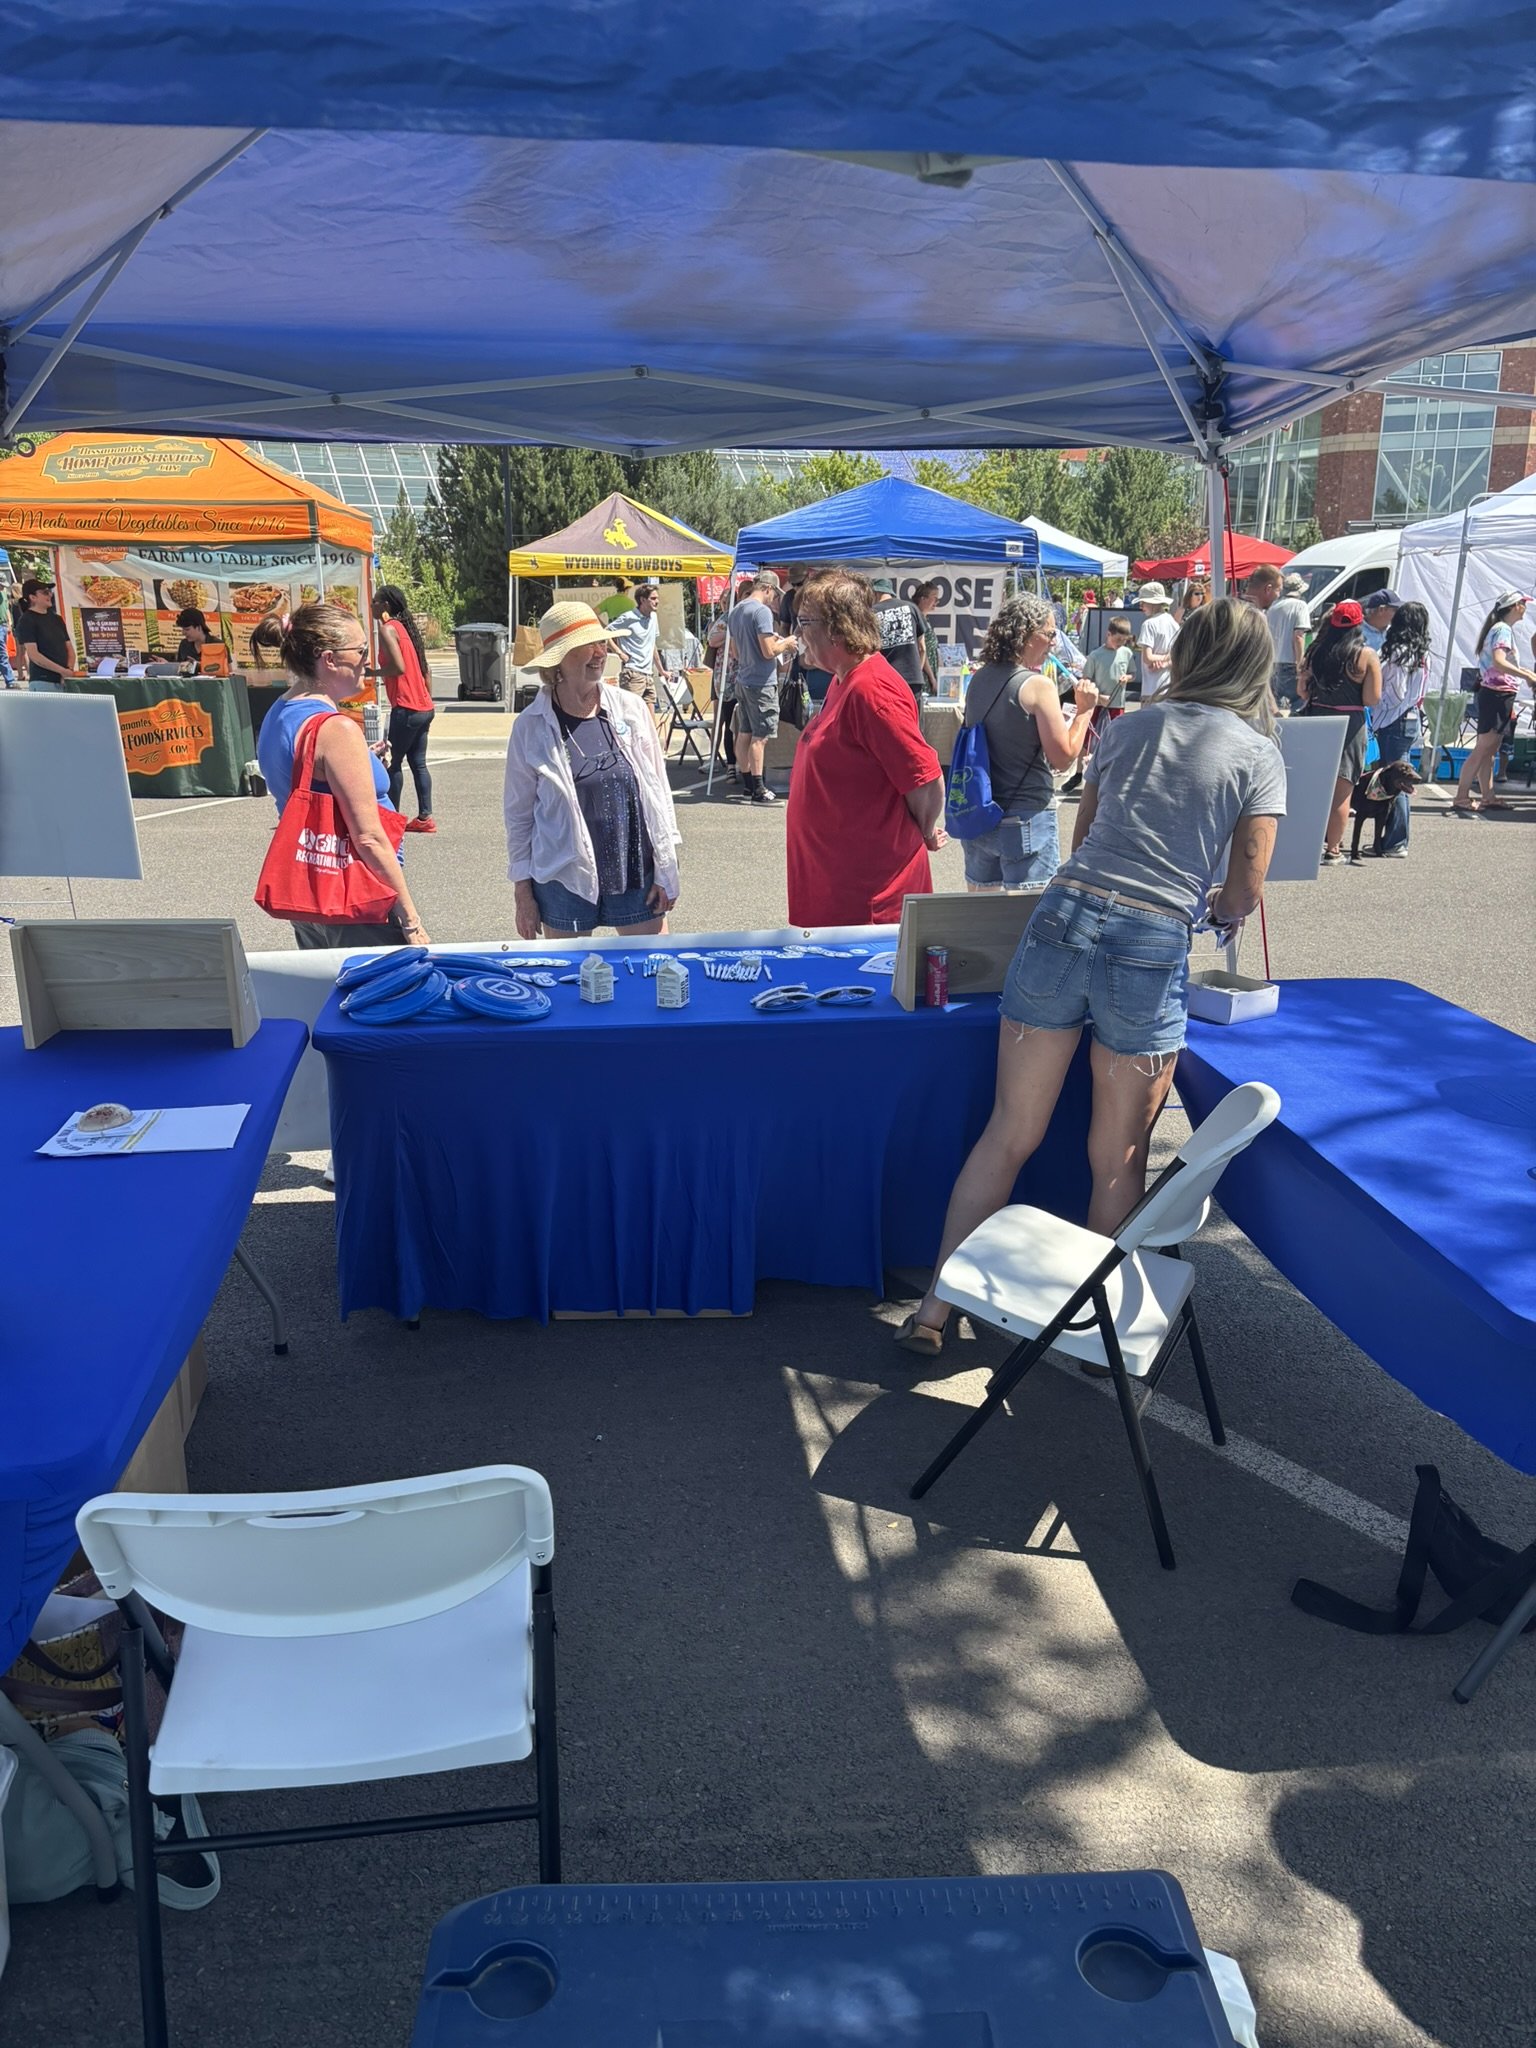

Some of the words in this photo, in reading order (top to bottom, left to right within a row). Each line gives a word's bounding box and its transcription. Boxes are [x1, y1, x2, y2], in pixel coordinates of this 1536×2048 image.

[8, 507, 68, 530] Meats
[75, 512, 104, 529] and
[105, 506, 189, 535] Vegetables
[195, 510, 243, 532] Since
[249, 516, 286, 532] 1916
[138, 549, 185, 563] FARM
[189, 551, 213, 563] TO
[217, 552, 267, 567] TABLE
[271, 554, 317, 567] SINCE
[323, 552, 355, 565] 1916
[565, 556, 621, 570] WYOMING
[626, 558, 682, 571] COWBOYS
[169, 744, 189, 754] .COM
